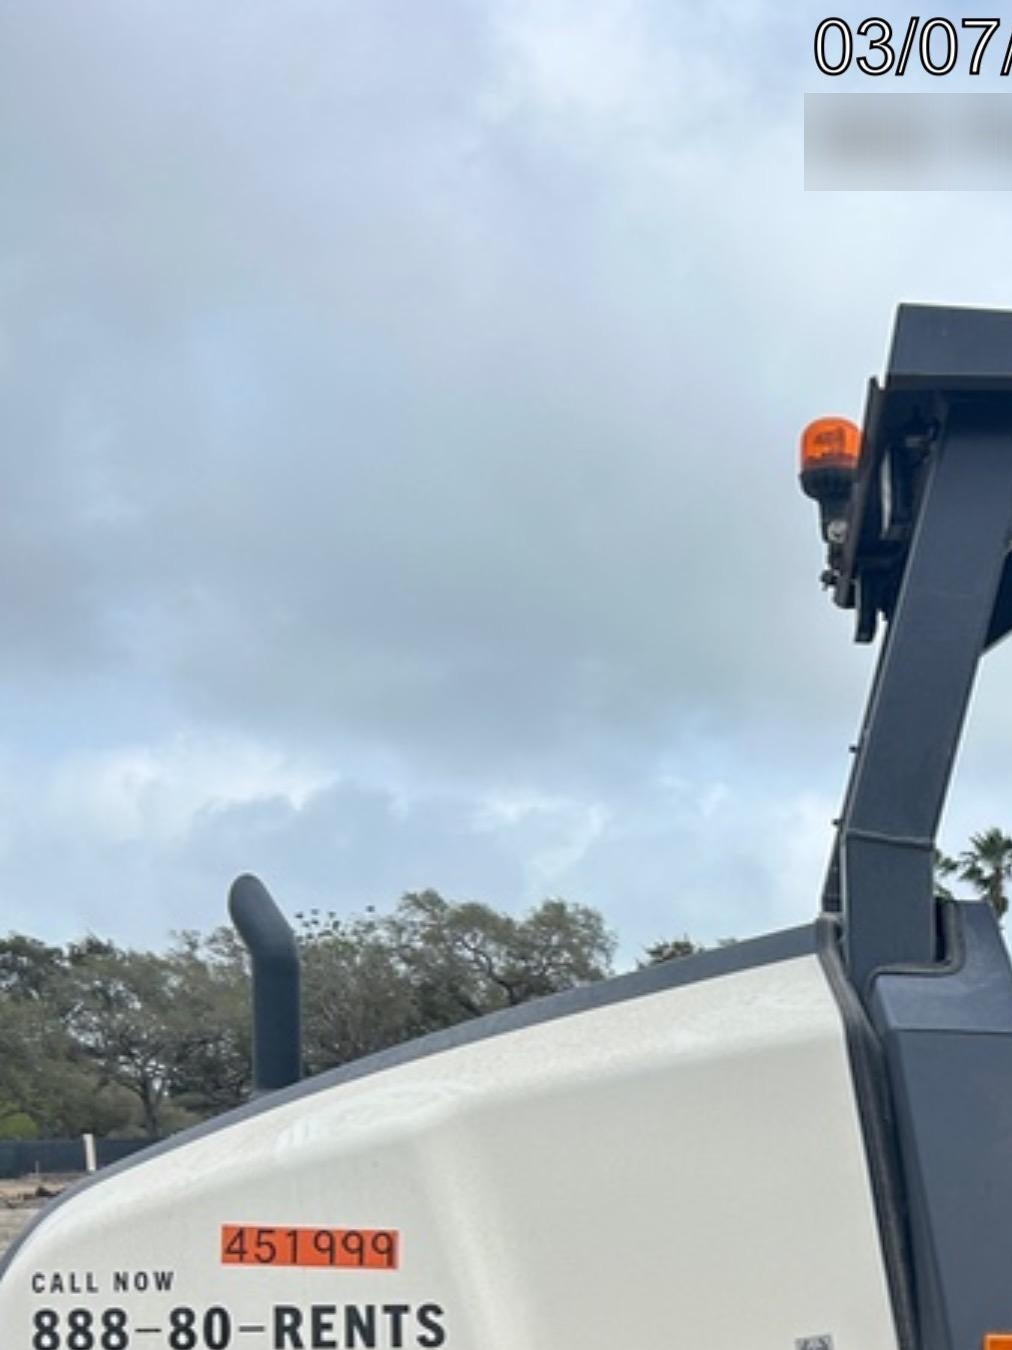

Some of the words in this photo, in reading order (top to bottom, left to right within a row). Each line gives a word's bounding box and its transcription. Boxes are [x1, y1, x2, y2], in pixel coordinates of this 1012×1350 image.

[225, 1227, 394, 1267] 451999
[32, 1272, 98, 1294] CALL
[114, 1270, 174, 1292] NOW
